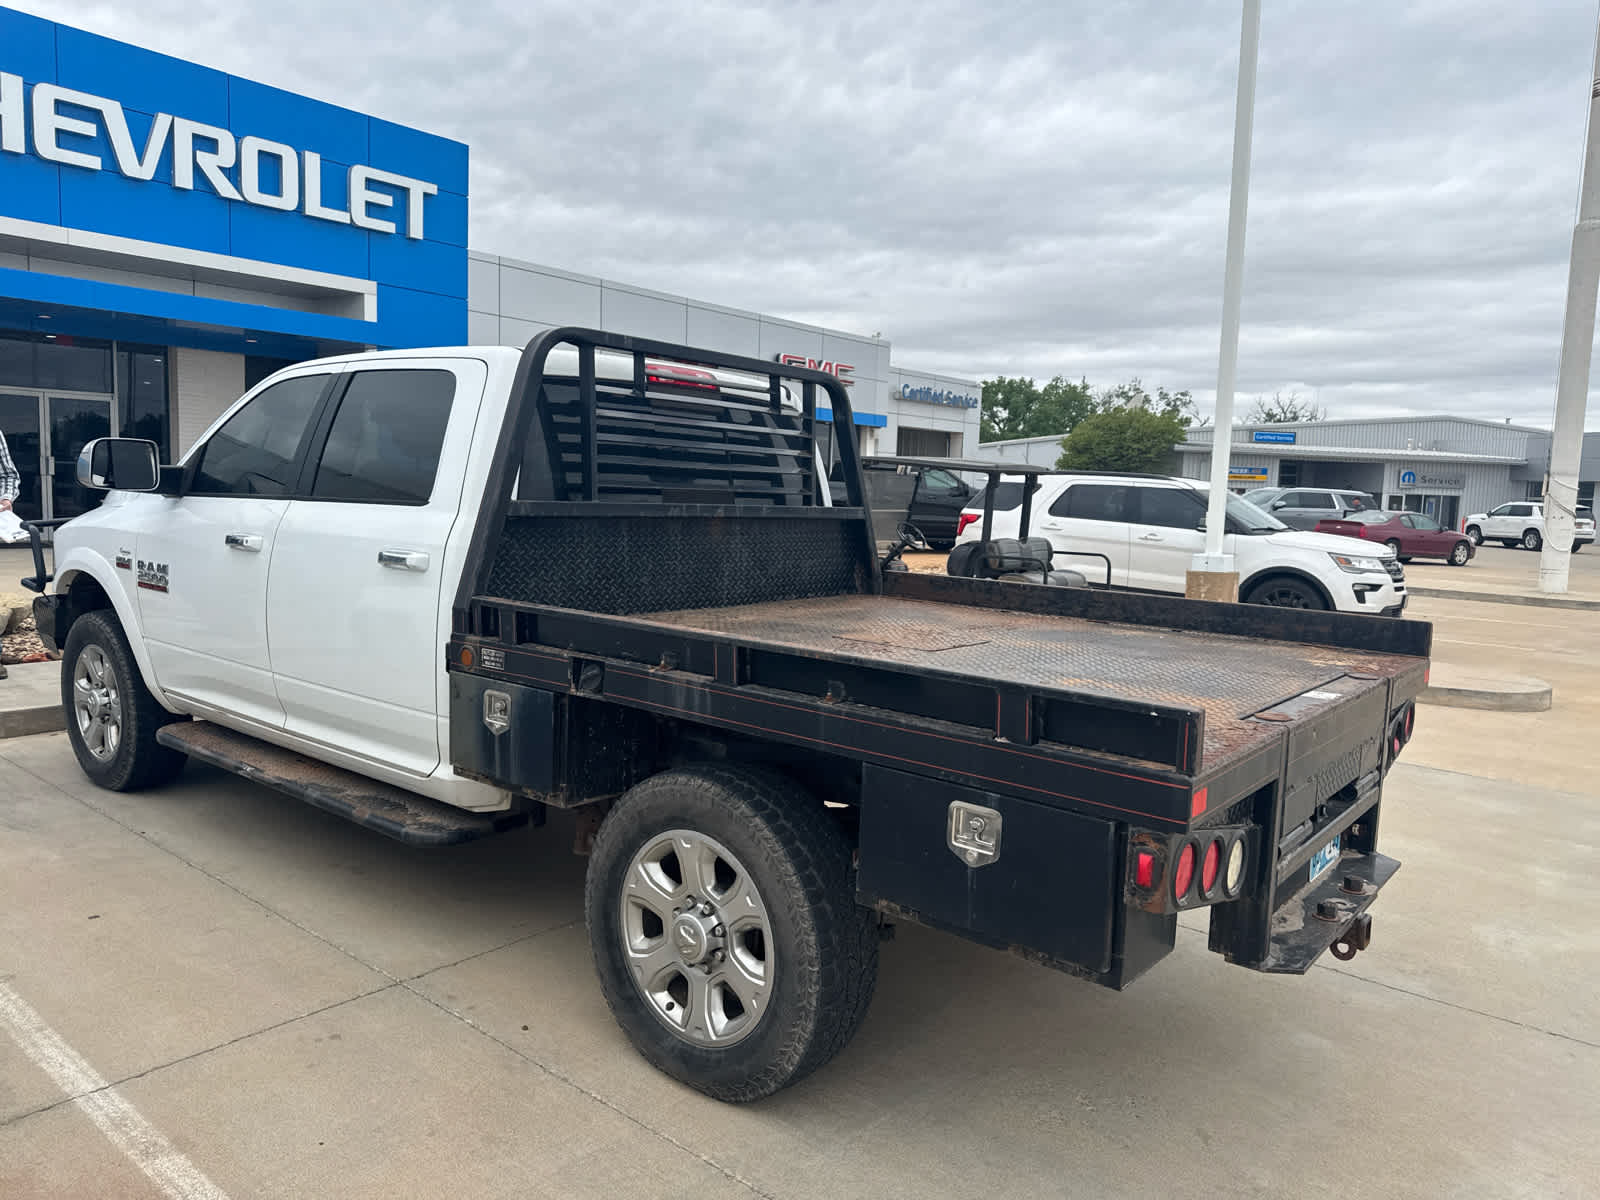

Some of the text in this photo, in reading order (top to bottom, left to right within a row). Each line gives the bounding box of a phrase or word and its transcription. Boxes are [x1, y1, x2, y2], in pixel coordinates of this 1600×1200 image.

[902, 383, 978, 408] Certified Service
[1420, 474, 1460, 486] Service
[137, 559, 169, 576] RAM
